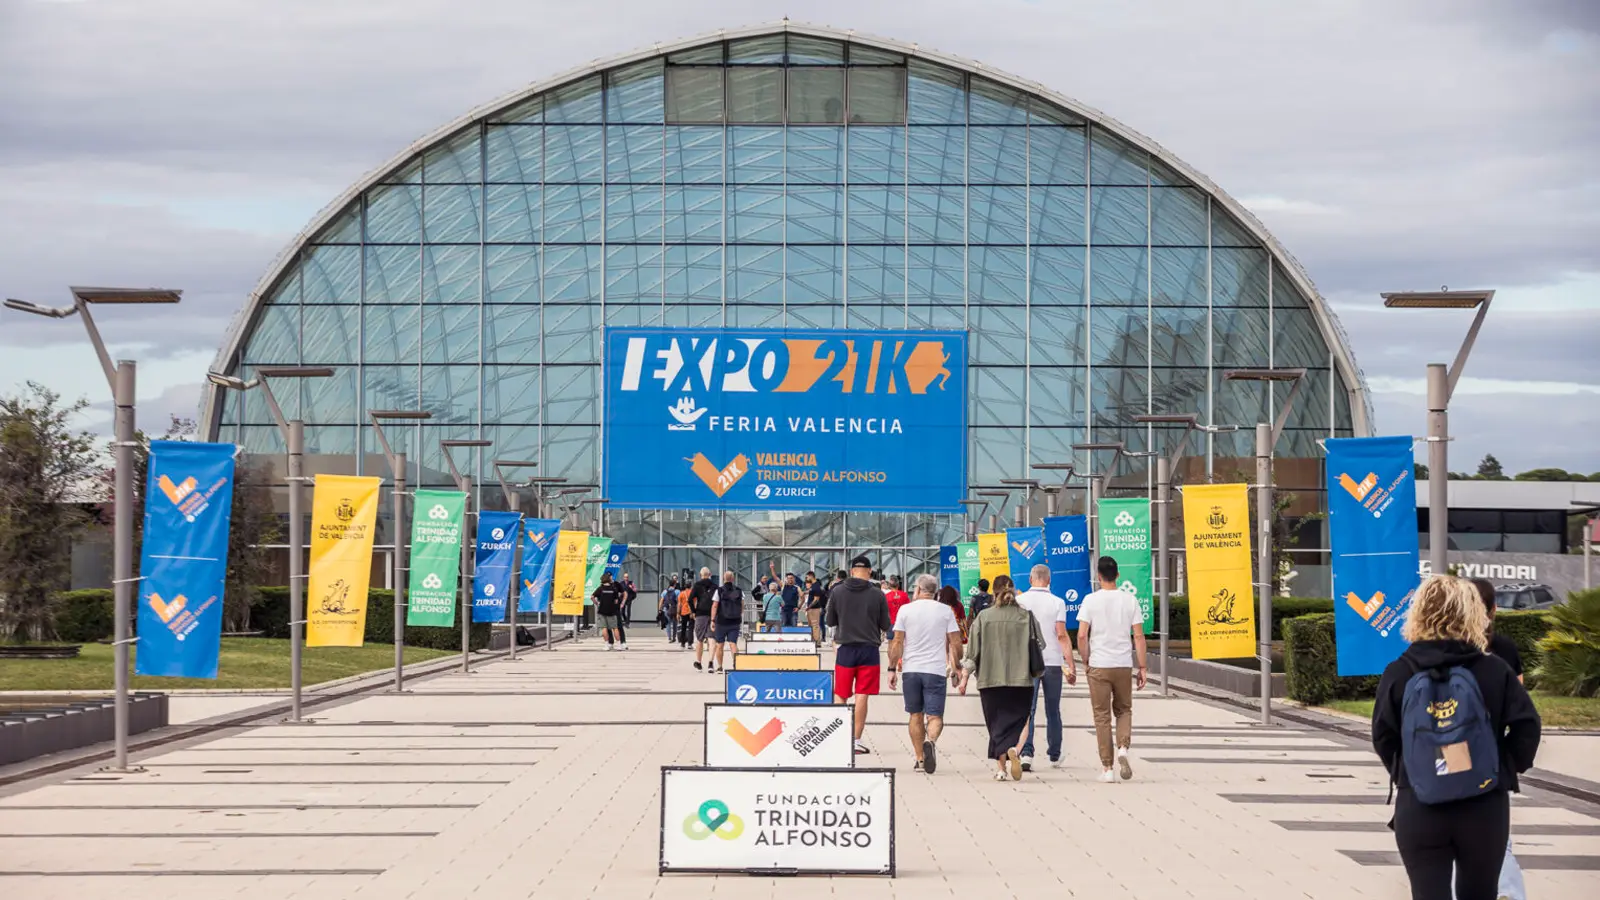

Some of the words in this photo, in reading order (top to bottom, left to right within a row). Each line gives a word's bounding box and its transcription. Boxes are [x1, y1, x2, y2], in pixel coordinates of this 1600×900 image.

[626, 337, 790, 392] EXPO
[803, 339, 920, 394] 21K
[709, 416, 776, 432] FERIA
[788, 417, 903, 434] VALENCIA
[756, 452, 818, 467] VALENCIA
[717, 461, 743, 490] 21K
[756, 469, 819, 482] TRINIDAD
[822, 471, 887, 483] ALFONSO
[775, 487, 817, 497] ZURICH
[1103, 535, 1147, 543] TRINIDAD
[1193, 532, 1242, 540] AJUNTAMENT
[481, 542, 512, 550] ZURICH
[1051, 545, 1085, 556] ZURICH
[475, 599, 503, 607] ZURICH
[764, 688, 825, 701] ZURICH
[792, 726, 821, 751] CIUDAD
[799, 742, 816, 758] DEL
[810, 717, 844, 747] RUNNING
[756, 792, 871, 806] FUNDACIÓN
[754, 809, 872, 828] TRINIDAD
[754, 829, 872, 848] ALFONSO
